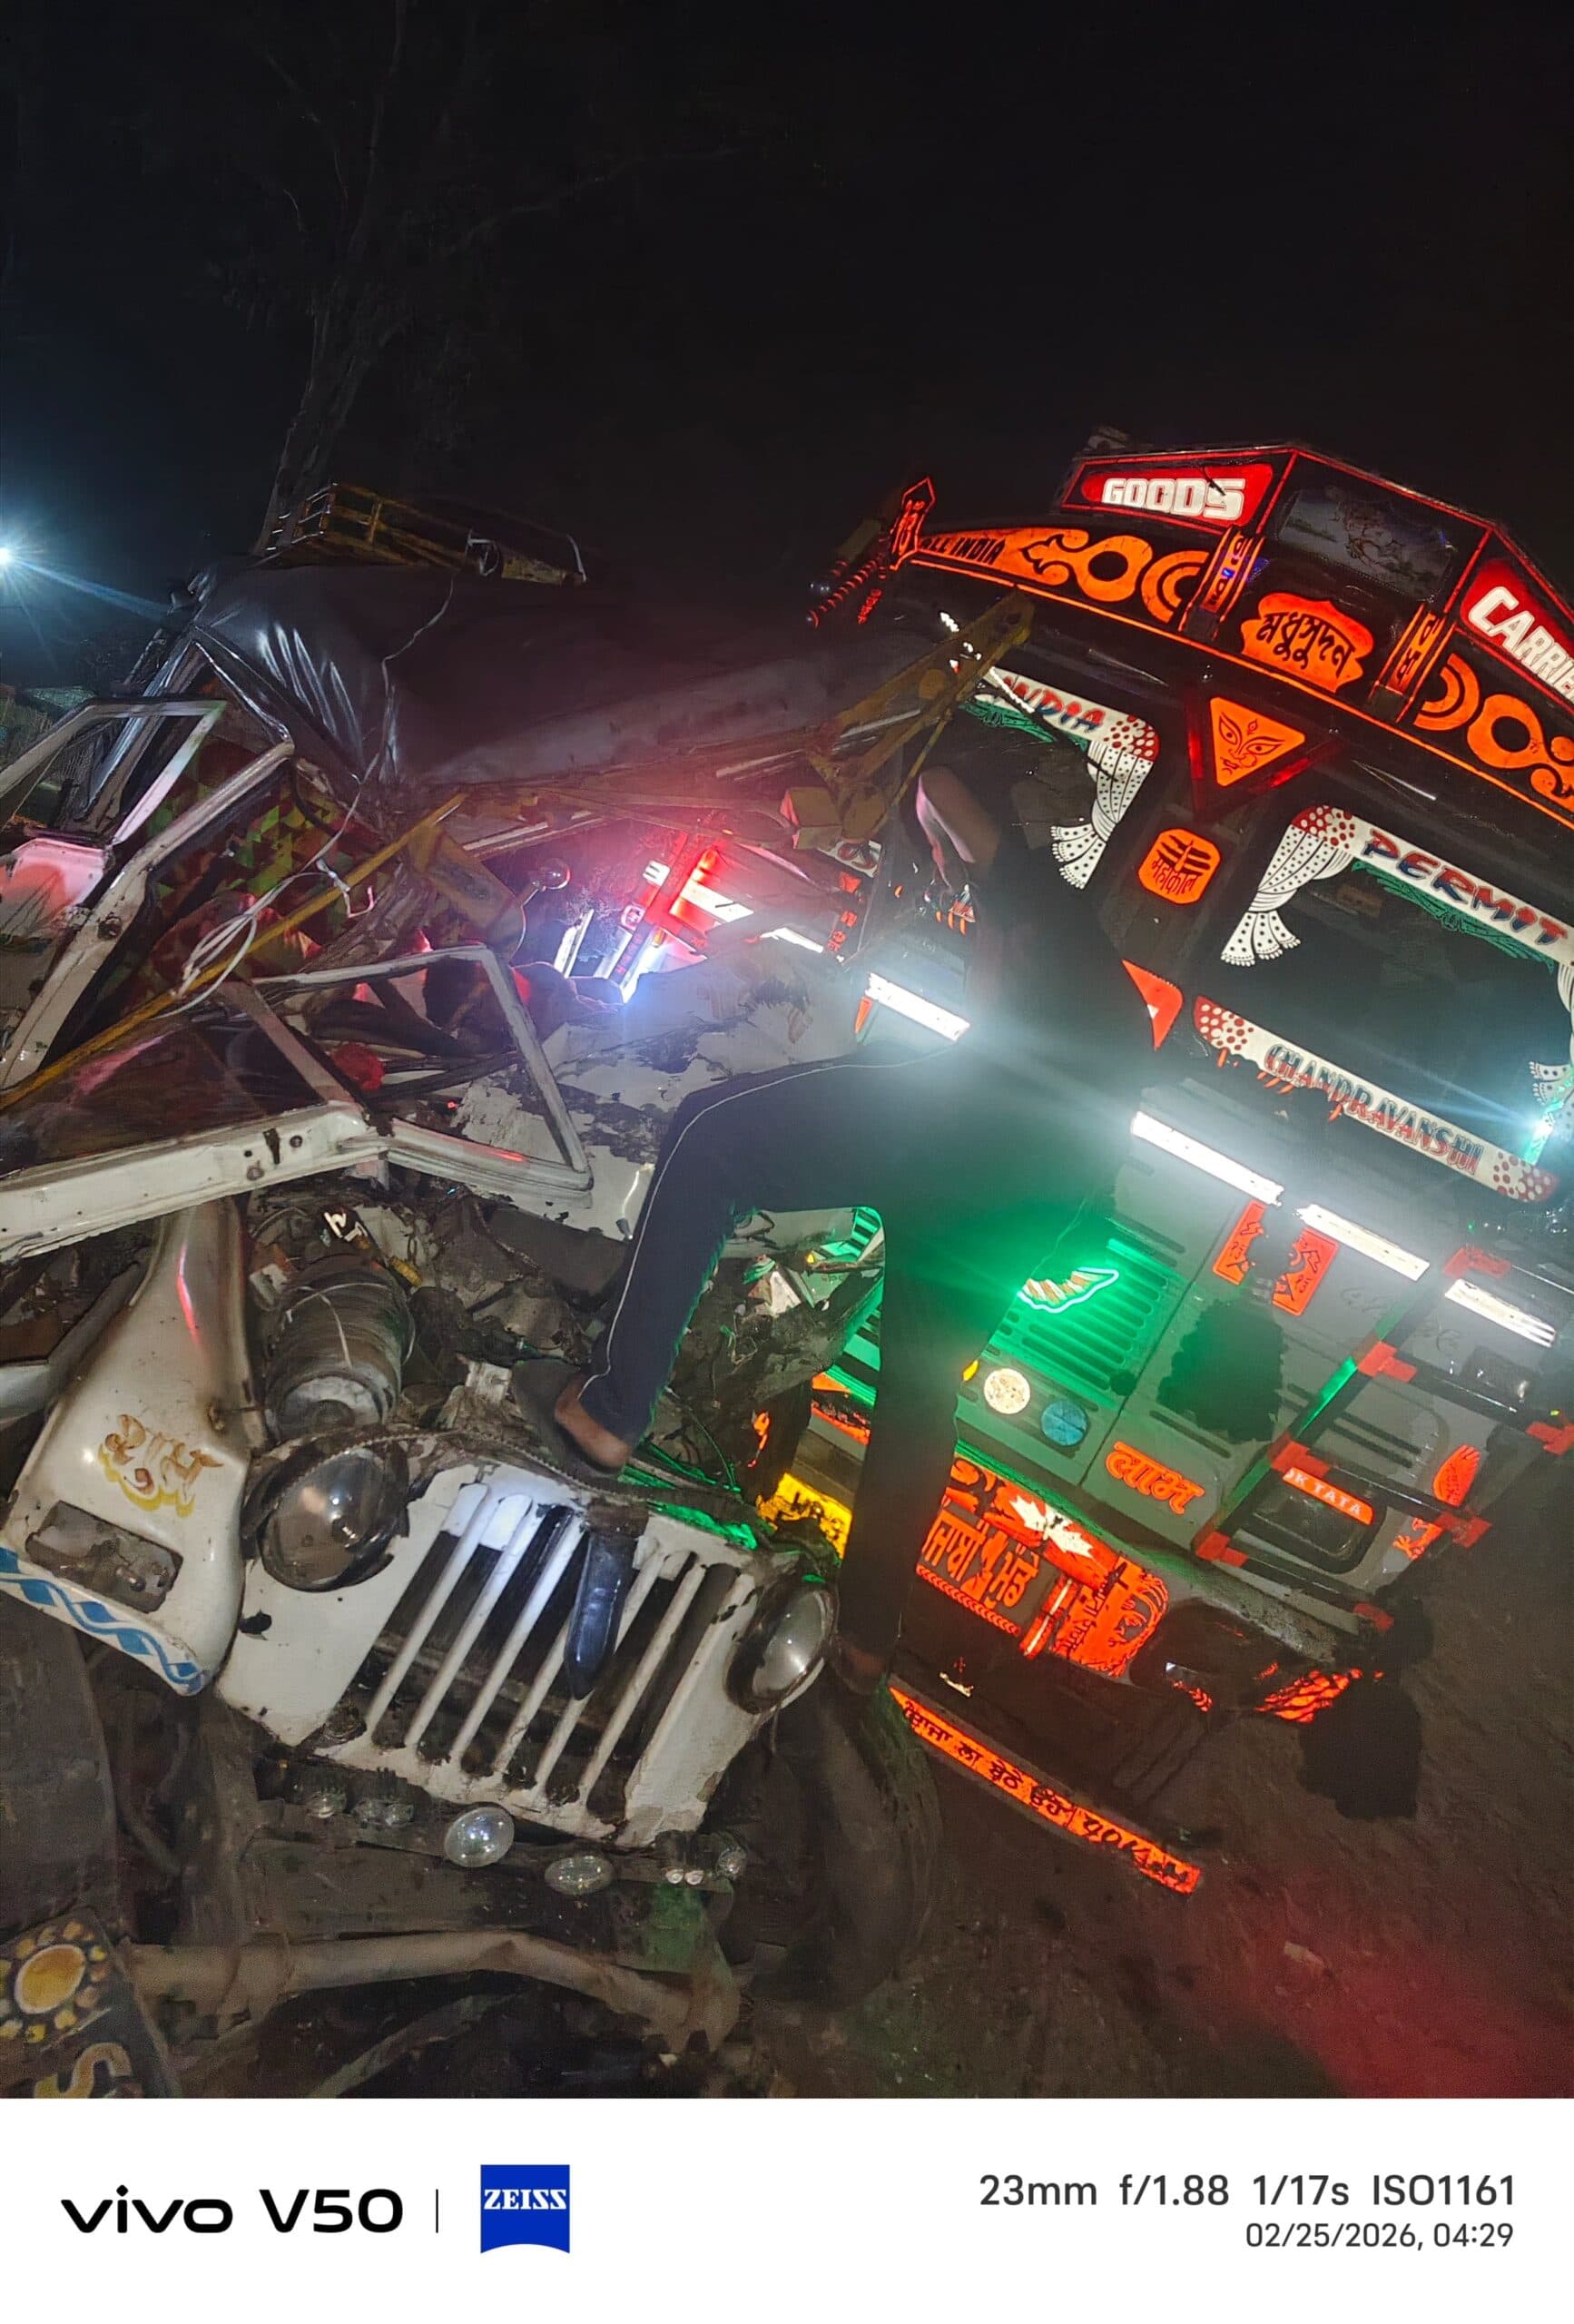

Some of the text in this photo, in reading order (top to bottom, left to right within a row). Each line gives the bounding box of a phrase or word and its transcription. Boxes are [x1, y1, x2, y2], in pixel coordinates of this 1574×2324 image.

[1101, 478, 1246, 521] GOODS
[949, 537, 1006, 566] INDIA
[1362, 828, 1569, 945] PERMIT
[1264, 1044, 1485, 1176] CHANDRAVANSHI
[1314, 1482, 1362, 1515] TATA
